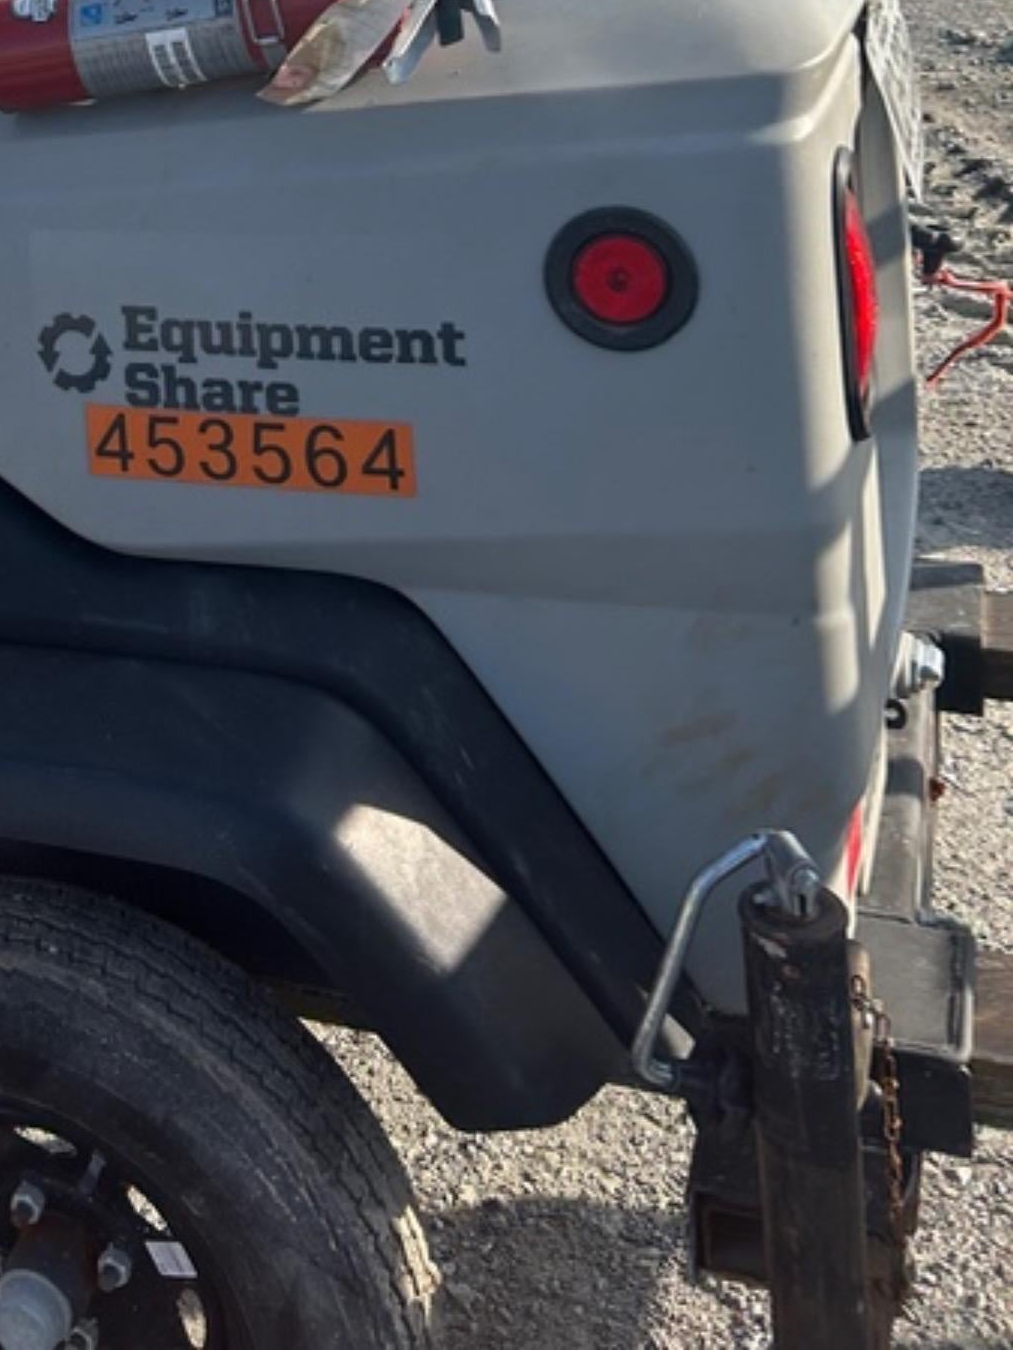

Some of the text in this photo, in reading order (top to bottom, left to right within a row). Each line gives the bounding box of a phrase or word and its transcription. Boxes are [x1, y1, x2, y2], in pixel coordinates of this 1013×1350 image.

[121, 305, 468, 369] Equipment
[124, 361, 300, 417] Share
[94, 412, 406, 491] 453564
